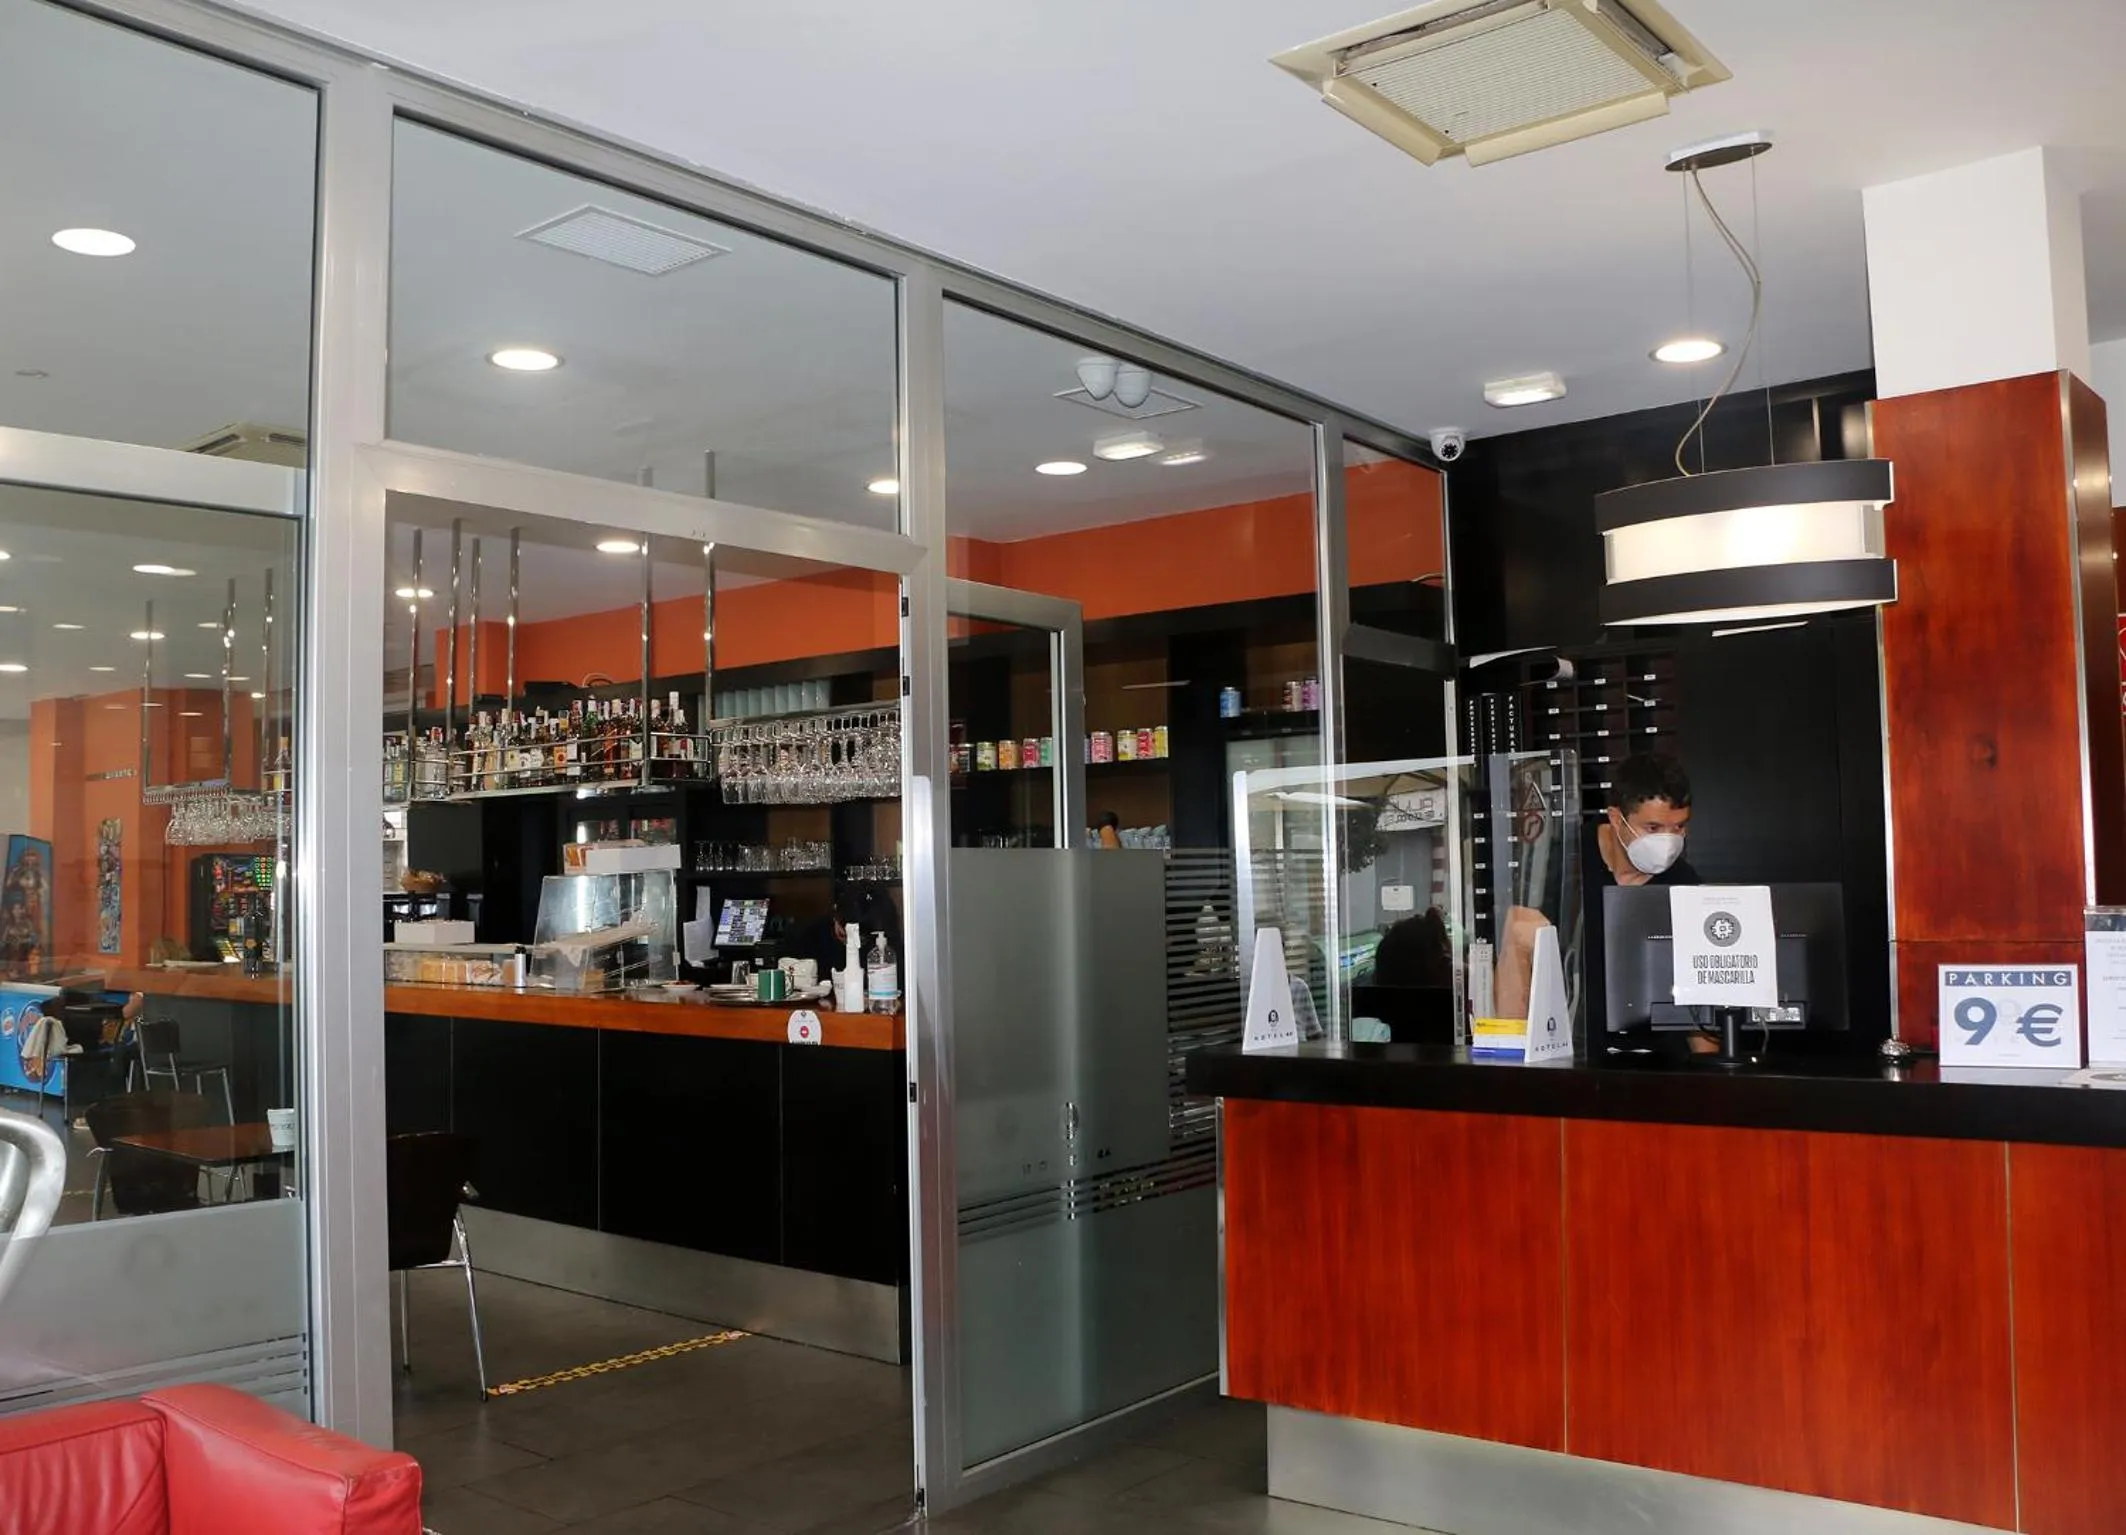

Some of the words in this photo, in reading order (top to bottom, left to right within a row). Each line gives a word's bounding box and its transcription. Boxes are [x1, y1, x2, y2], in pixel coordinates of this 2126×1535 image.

[1693, 954, 1709, 969] USO
[1710, 954, 1759, 969] OBLIGATORIO
[1697, 970, 1707, 985] DE
[1707, 970, 1756, 985] MASCARILLA
[1948, 972, 2069, 986] PARKING
[1954, 997, 1998, 1046] 9
[2015, 1003, 2064, 1048] €
